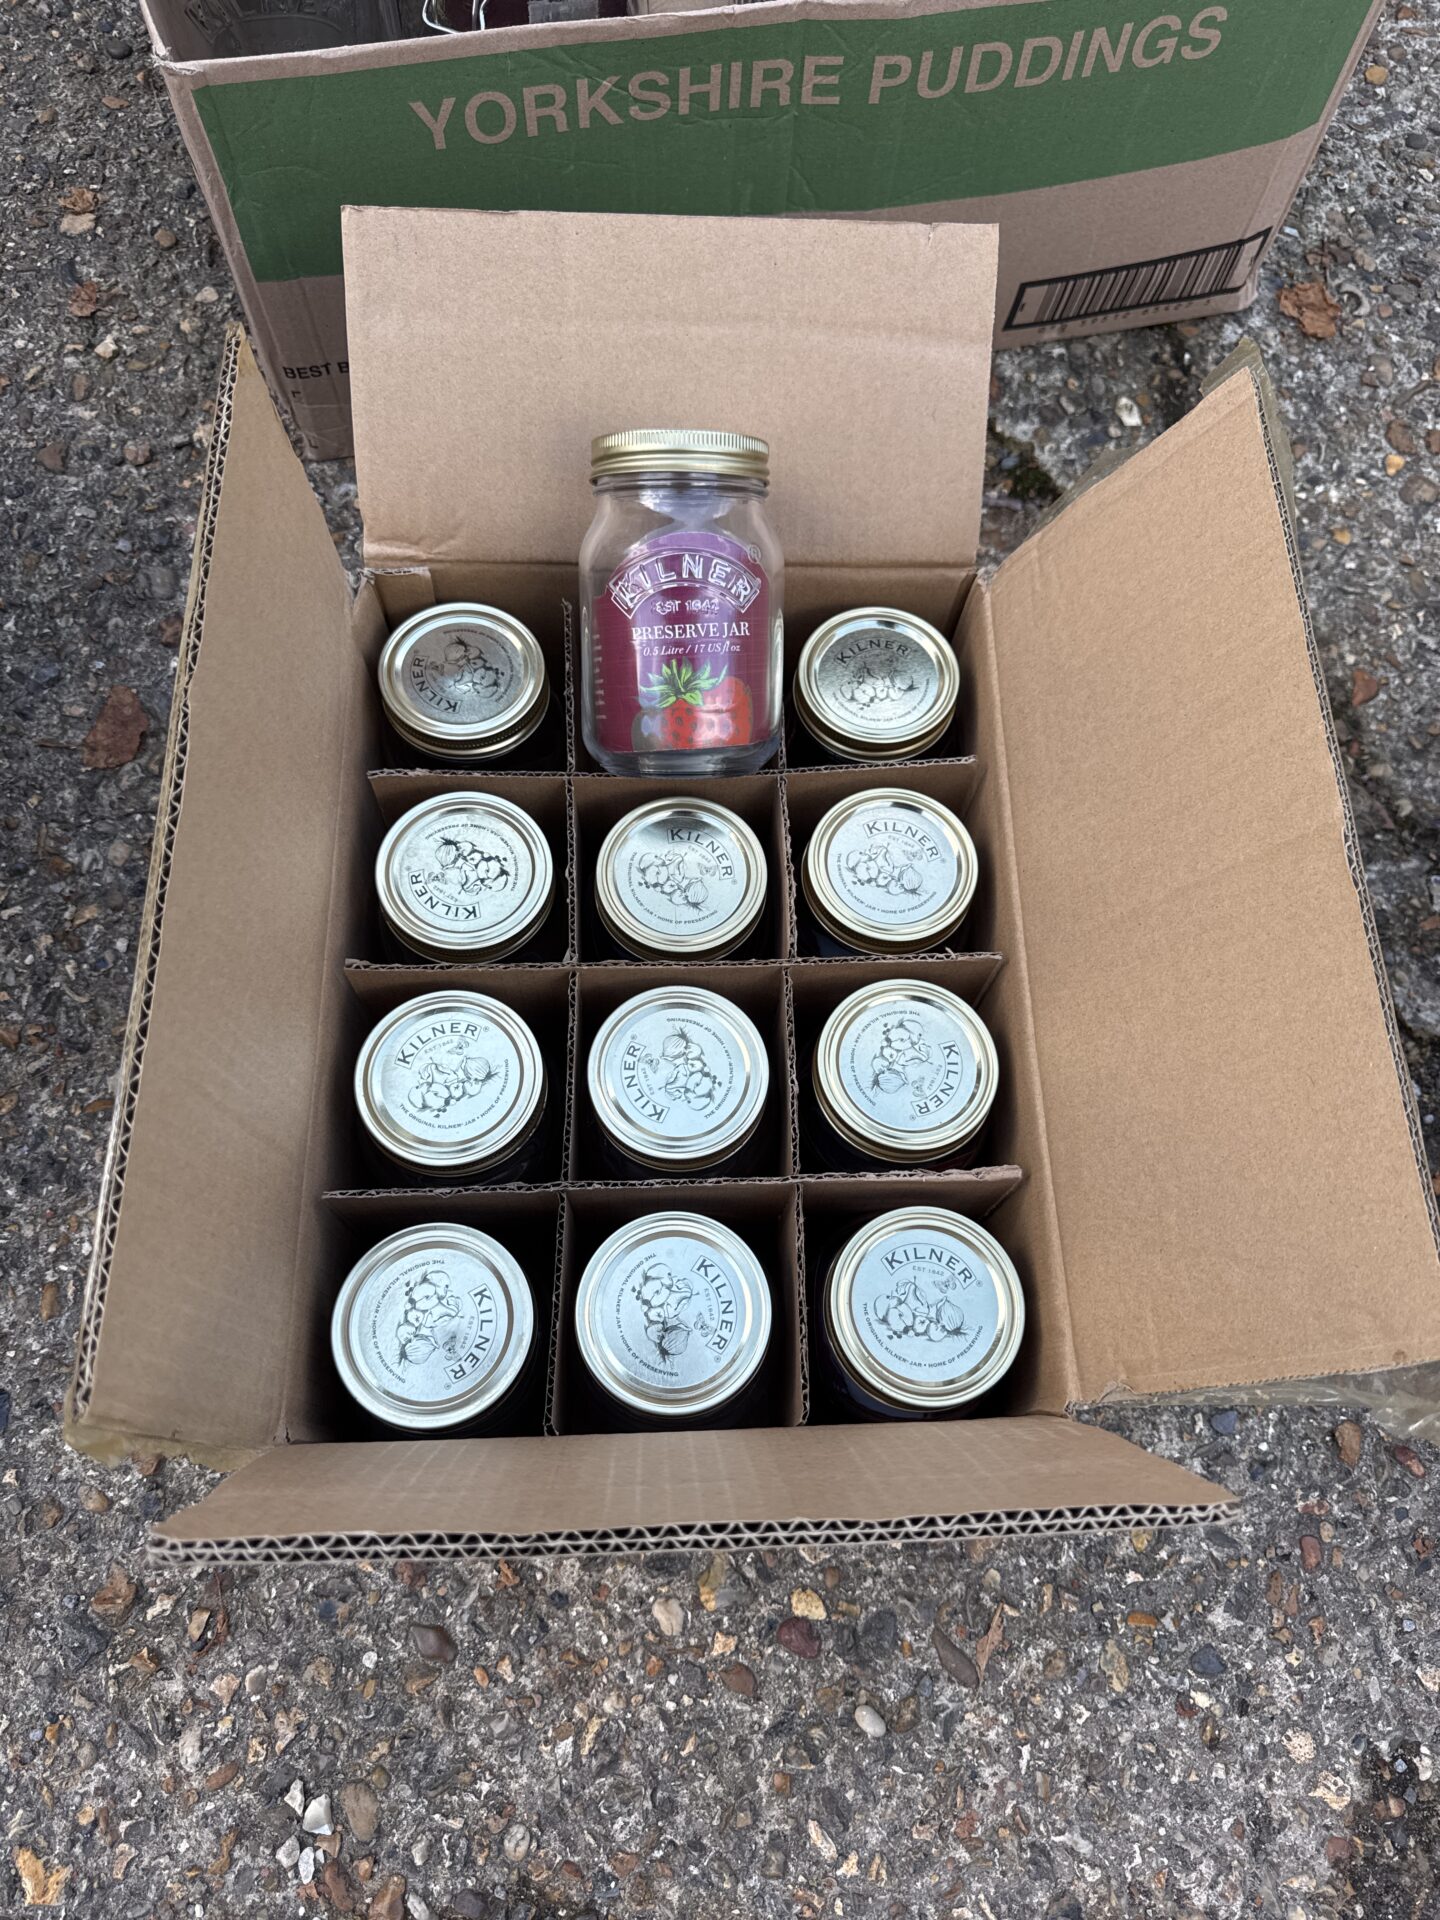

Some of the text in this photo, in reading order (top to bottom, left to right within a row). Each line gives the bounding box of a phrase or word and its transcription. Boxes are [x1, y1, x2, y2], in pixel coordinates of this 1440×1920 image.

[409, 5, 1229, 150] YORKSHIRE PUDDINGS
[282, 362, 332, 380] BEST
[616, 554, 751, 608] KILNER
[632, 621, 750, 640] PRESERVE JAR
[643, 646, 659, 656] 0.5
[660, 646, 685, 655] Litre
[694, 644, 706, 653] 17
[836, 639, 909, 665] KILNER
[413, 657, 458, 712] KILNER
[670, 829, 732, 877] KILNER
[867, 821, 939, 858] KILNER
[411, 873, 477, 919] KILNER
[397, 1022, 478, 1065] KILNER
[624, 1044, 665, 1121] KILNER
[916, 1044, 959, 1115] KILNER
[885, 1247, 973, 1283] KILNER
[697, 1258, 734, 1350] KILNER
[451, 1288, 493, 1380] KILNER
[866, 1316, 884, 1348] ORIGINAL
[884, 1346, 906, 1362] KILNER
[909, 1359, 922, 1367] JAR
[956, 1325, 983, 1360] PRESERVING
